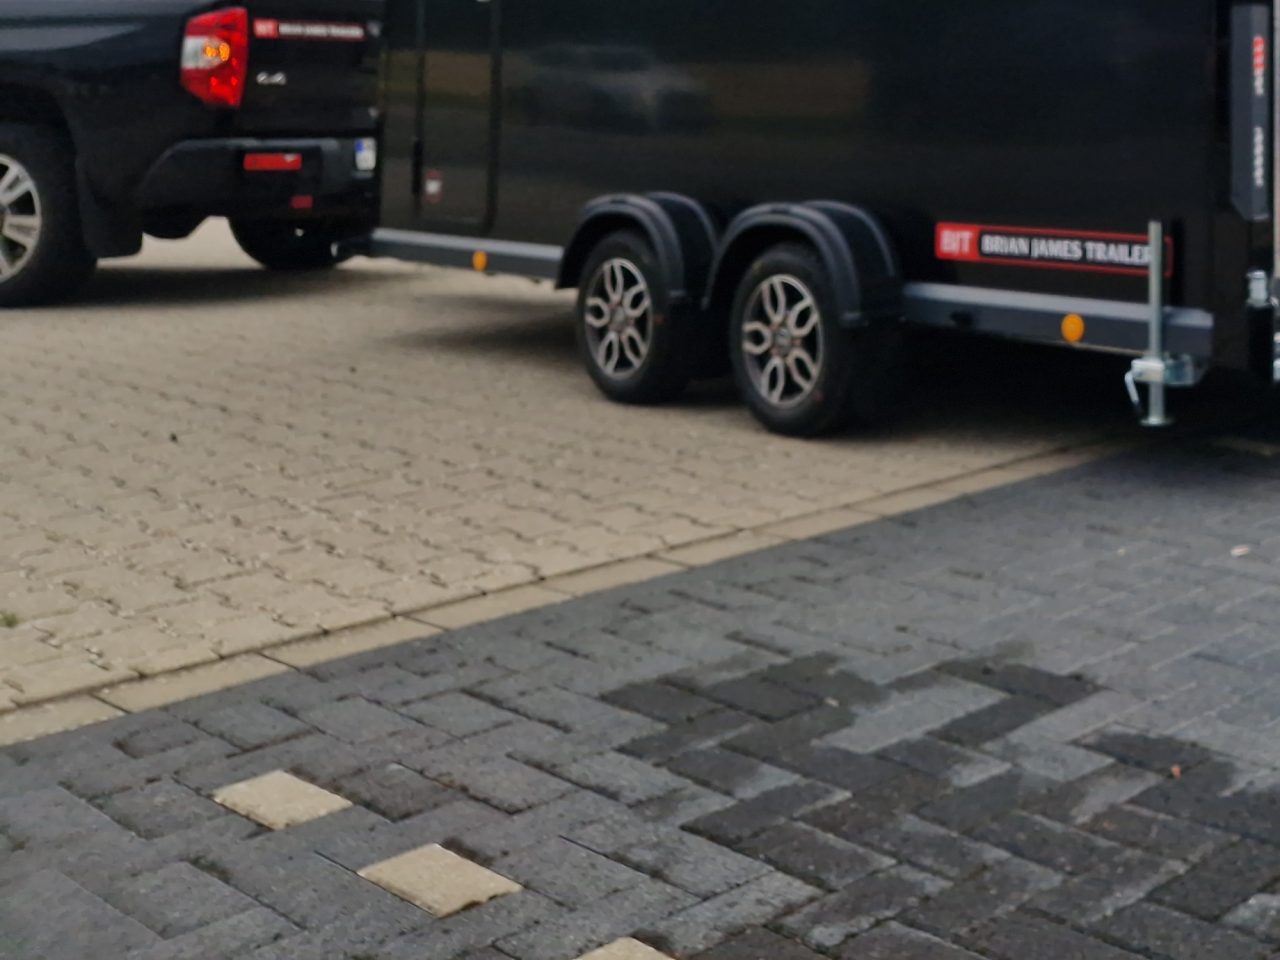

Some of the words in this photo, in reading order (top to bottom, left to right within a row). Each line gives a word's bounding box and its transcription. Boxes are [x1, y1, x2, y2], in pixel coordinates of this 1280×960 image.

[981, 234, 1030, 256] BRIAN
[1030, 237, 1083, 262] JAMES
[1083, 240, 1151, 267] TRAILER
